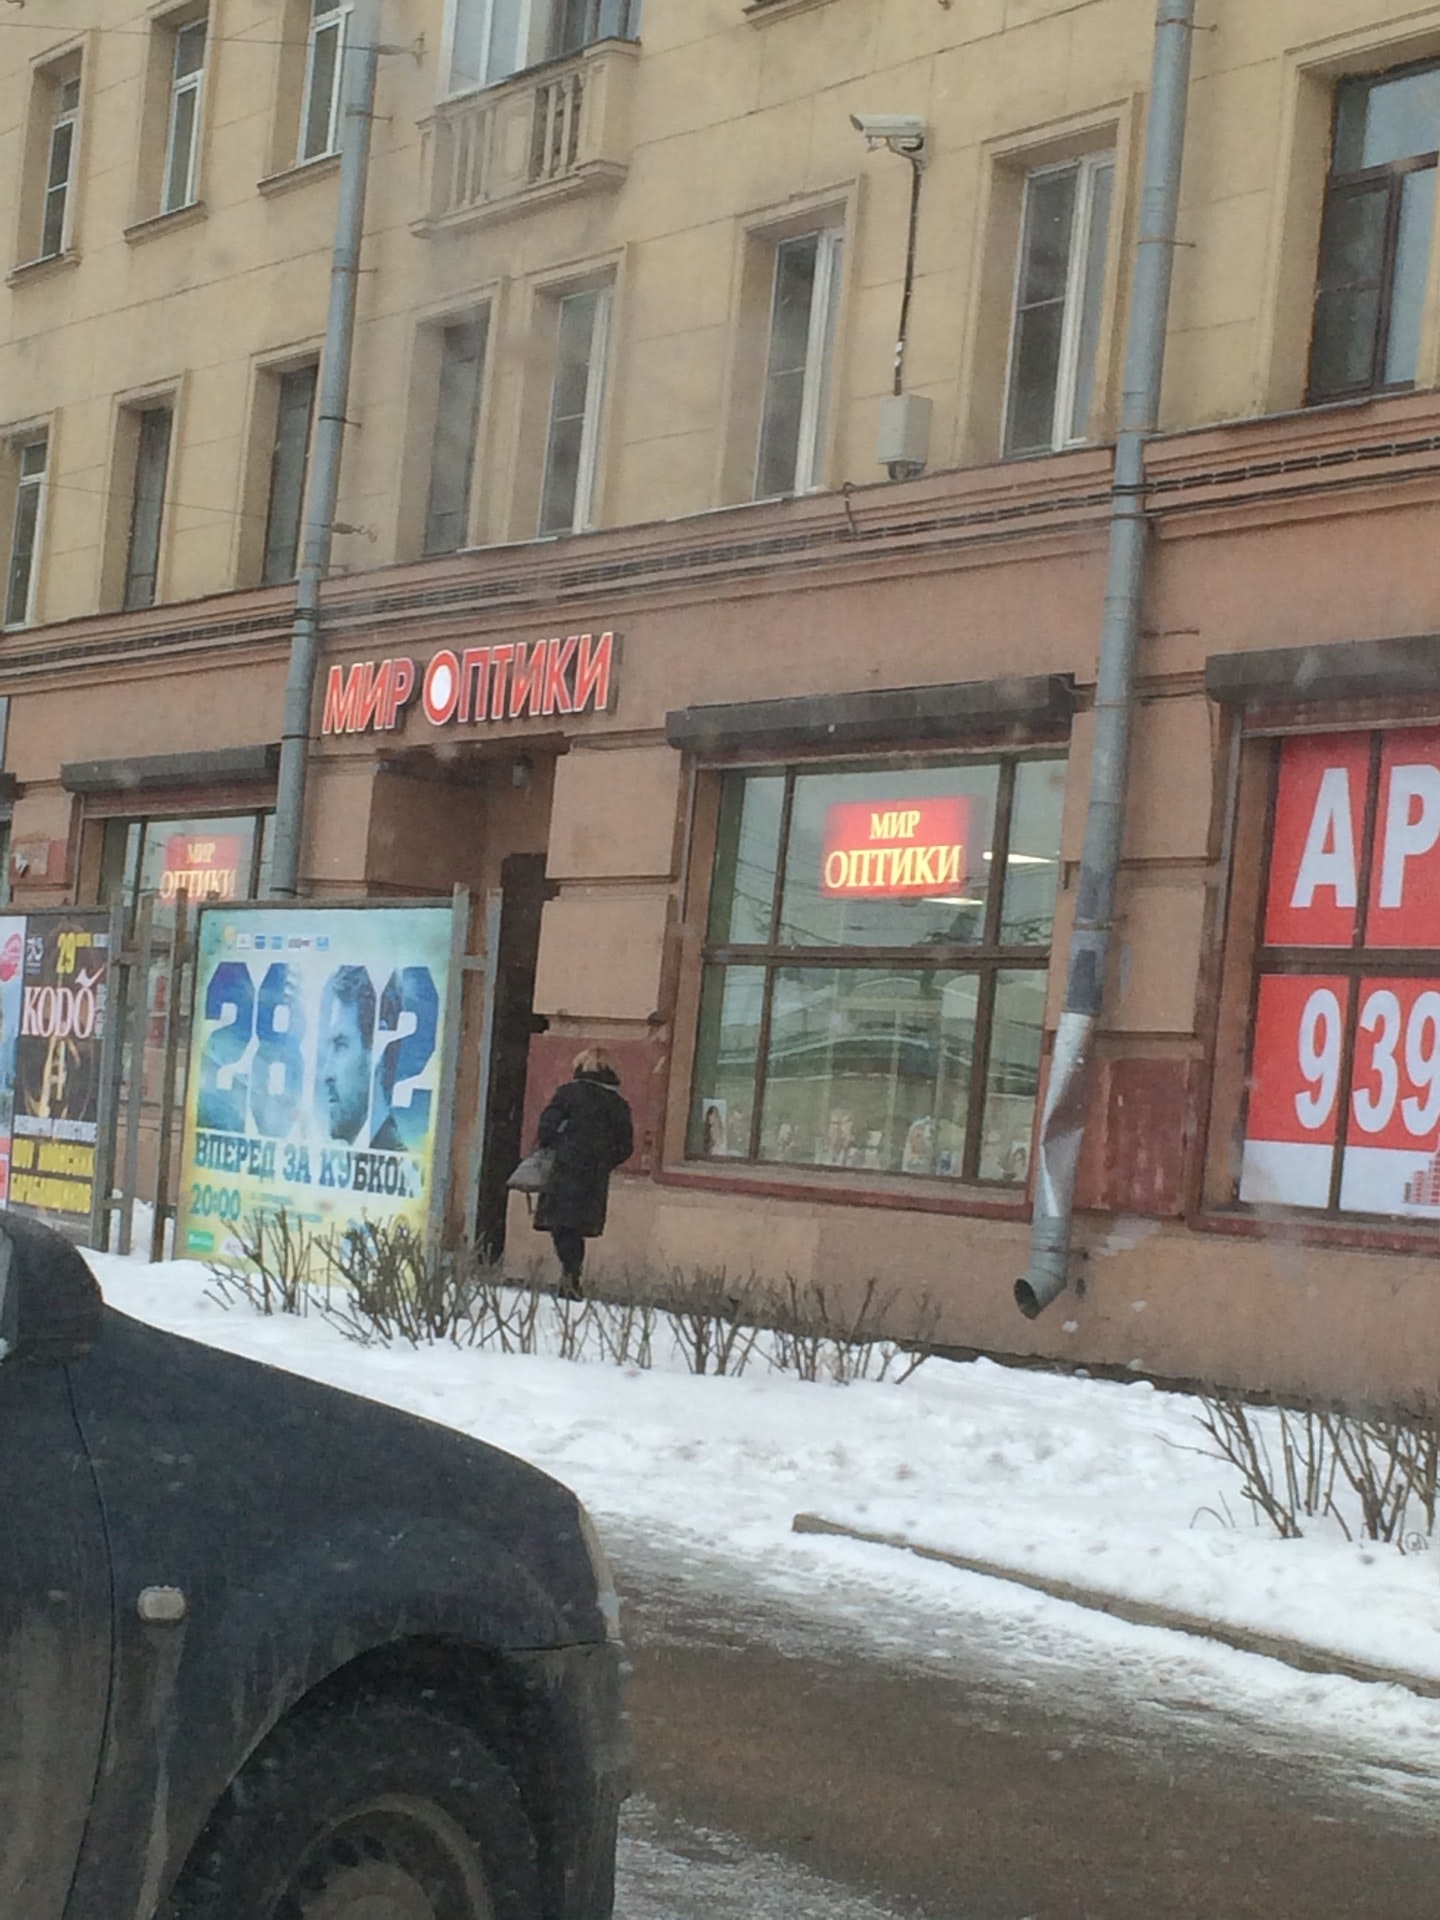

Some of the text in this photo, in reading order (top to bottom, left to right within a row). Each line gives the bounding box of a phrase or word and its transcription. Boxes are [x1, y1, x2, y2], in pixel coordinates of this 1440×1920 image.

[322, 632, 613, 734] МИР ОПТИКИ
[869, 810, 921, 840] МИР
[186, 841, 217, 864] МИР
[824, 845, 962, 889] ОПТИКИ
[1294, 989, 1440, 1135] 939
[194, 1132, 278, 1180] ВПЕРЕД
[283, 1145, 312, 1184] ЗА
